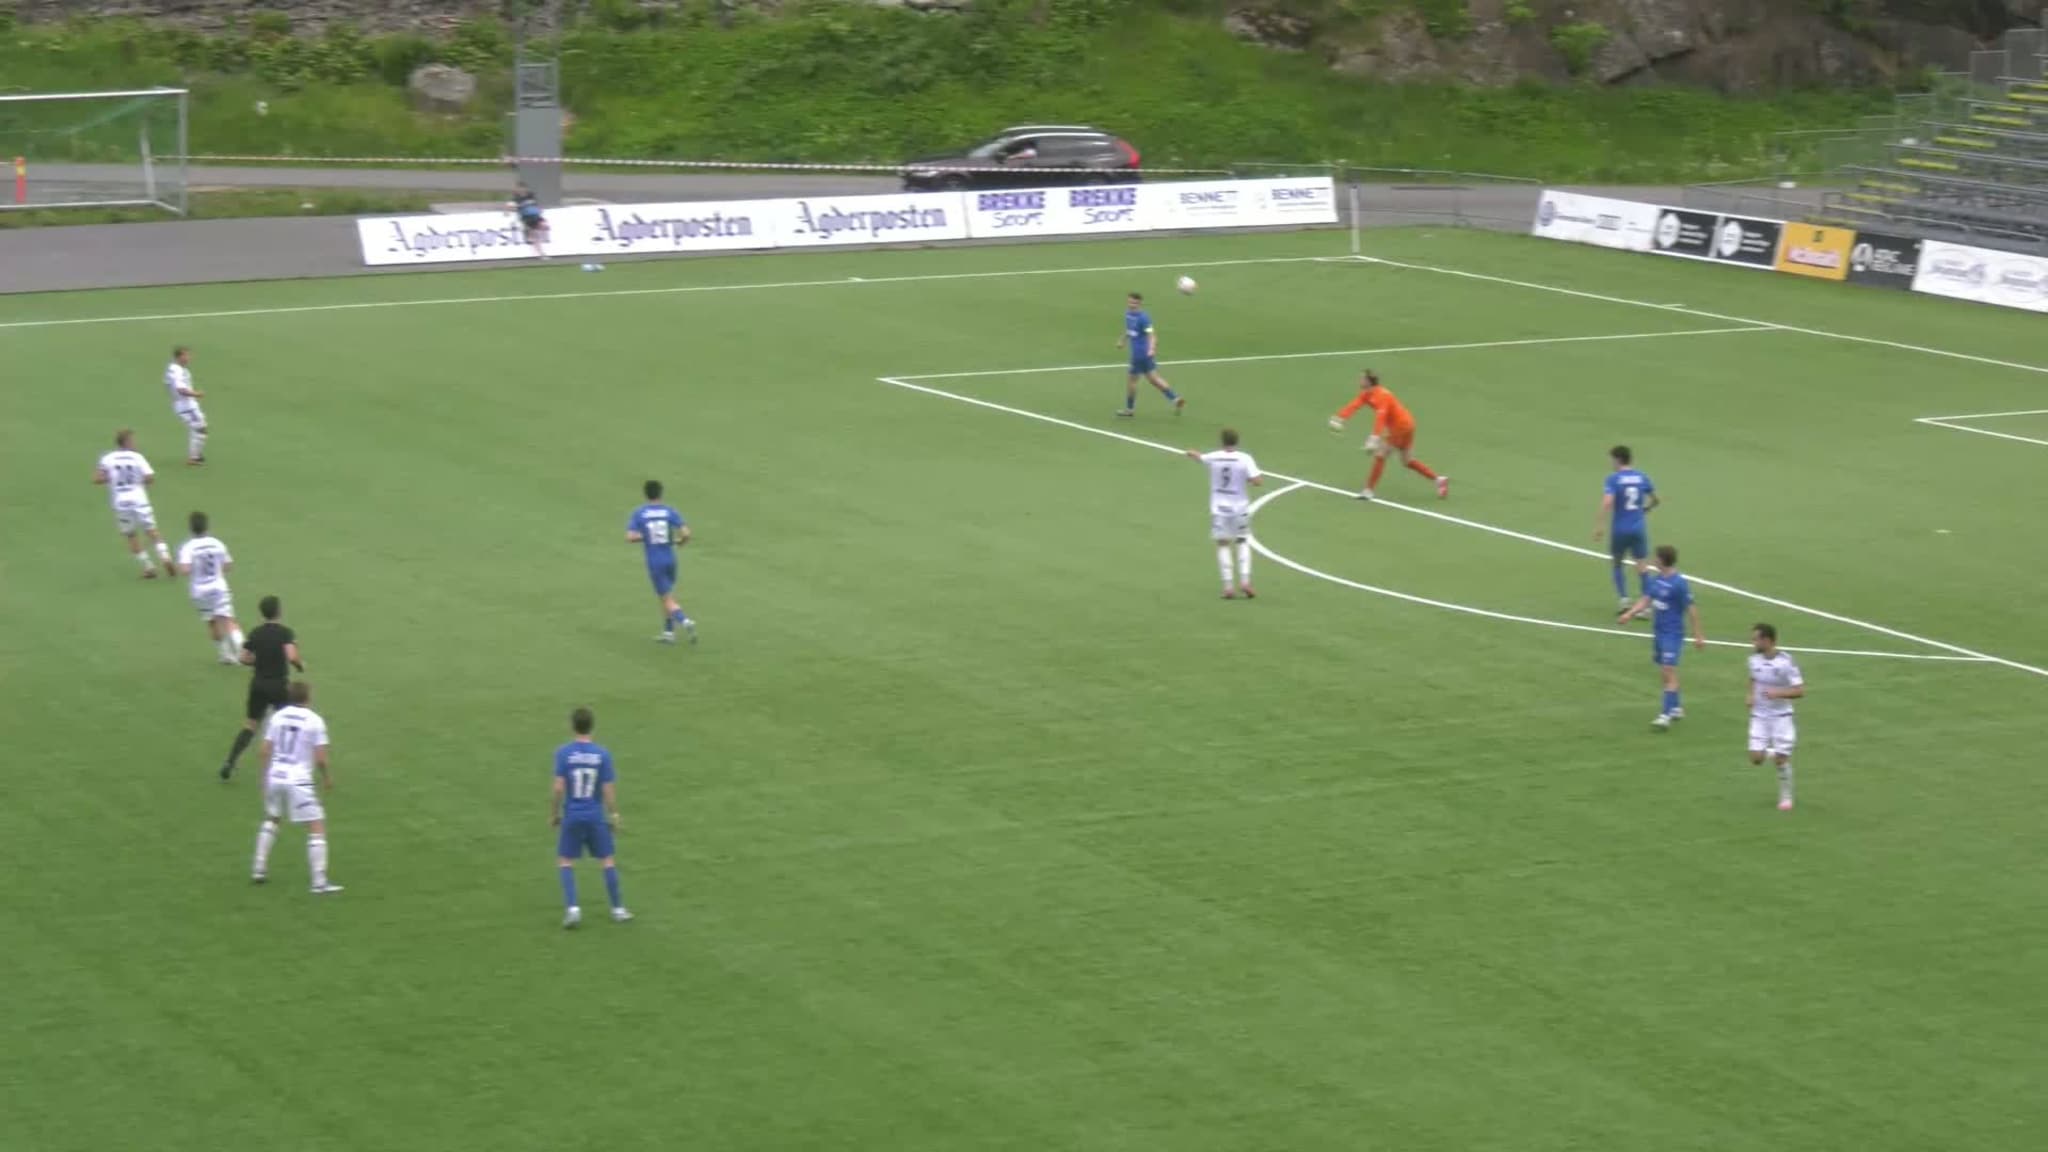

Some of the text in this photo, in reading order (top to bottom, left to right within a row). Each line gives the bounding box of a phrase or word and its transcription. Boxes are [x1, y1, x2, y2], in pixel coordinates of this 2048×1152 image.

[978, 191, 1046, 211] BREKKE
[1069, 188, 1137, 208] BREKKE
[387, 220, 551, 257] Agderpostn
[592, 208, 754, 247] Agderposten
[794, 202, 946, 243] Agderposten
[1624, 486, 1639, 511] 2
[281, 723, 302, 756] 17
[572, 767, 599, 799] 17
